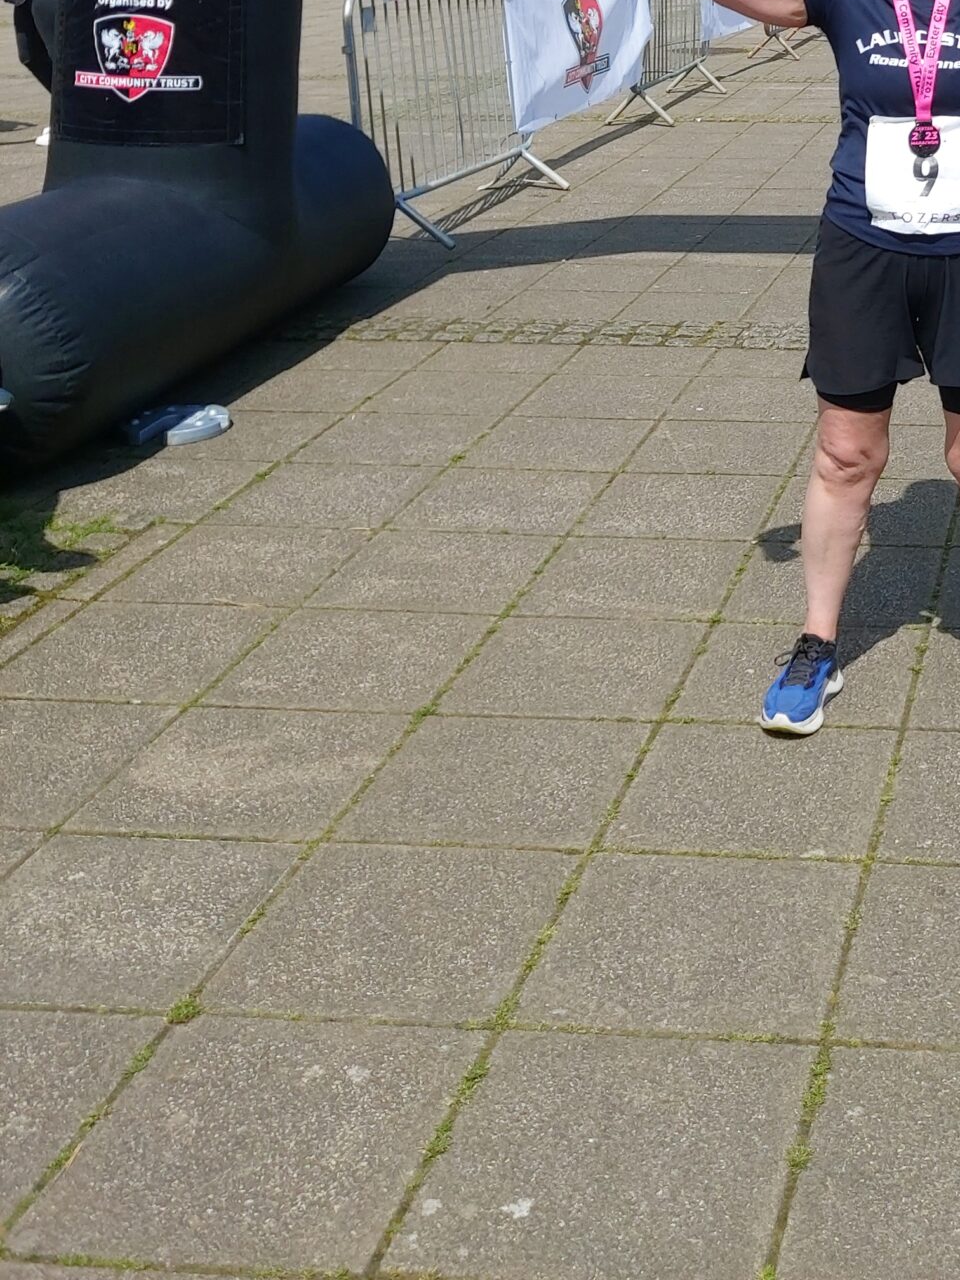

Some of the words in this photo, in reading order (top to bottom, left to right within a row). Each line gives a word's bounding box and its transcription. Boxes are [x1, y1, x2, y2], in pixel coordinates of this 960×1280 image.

[933, 2, 946, 23] City
[899, 4, 919, 66] Community
[927, 25, 940, 59] Exeter
[79, 74, 97, 85] CITY
[99, 76, 157, 88] COMMUNITY
[159, 78, 195, 88] TRUST
[912, 157, 939, 197] 9
